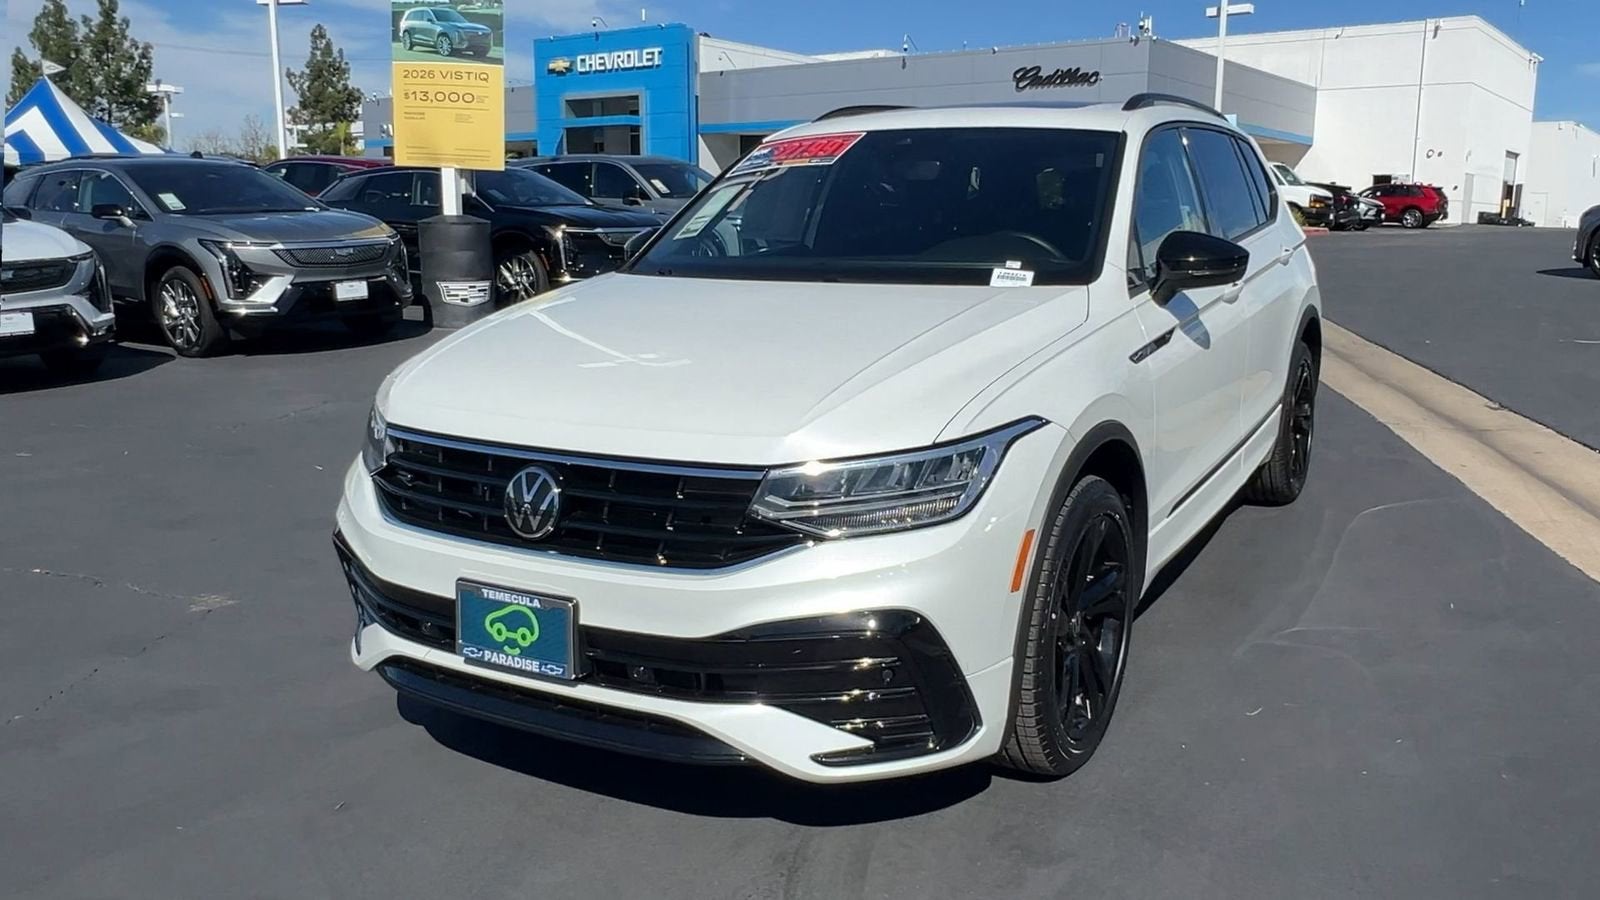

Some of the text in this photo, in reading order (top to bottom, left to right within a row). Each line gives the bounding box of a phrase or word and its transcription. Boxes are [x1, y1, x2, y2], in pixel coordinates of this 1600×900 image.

[577, 47, 662, 72] CHEVROLET
[403, 69, 490, 83] 2026 VISTIQ
[1013, 65, 1101, 91] Cadillac
[404, 91, 475, 104] $13,000
[481, 588, 541, 608] TEMECULA
[484, 650, 541, 672] PARADISE
